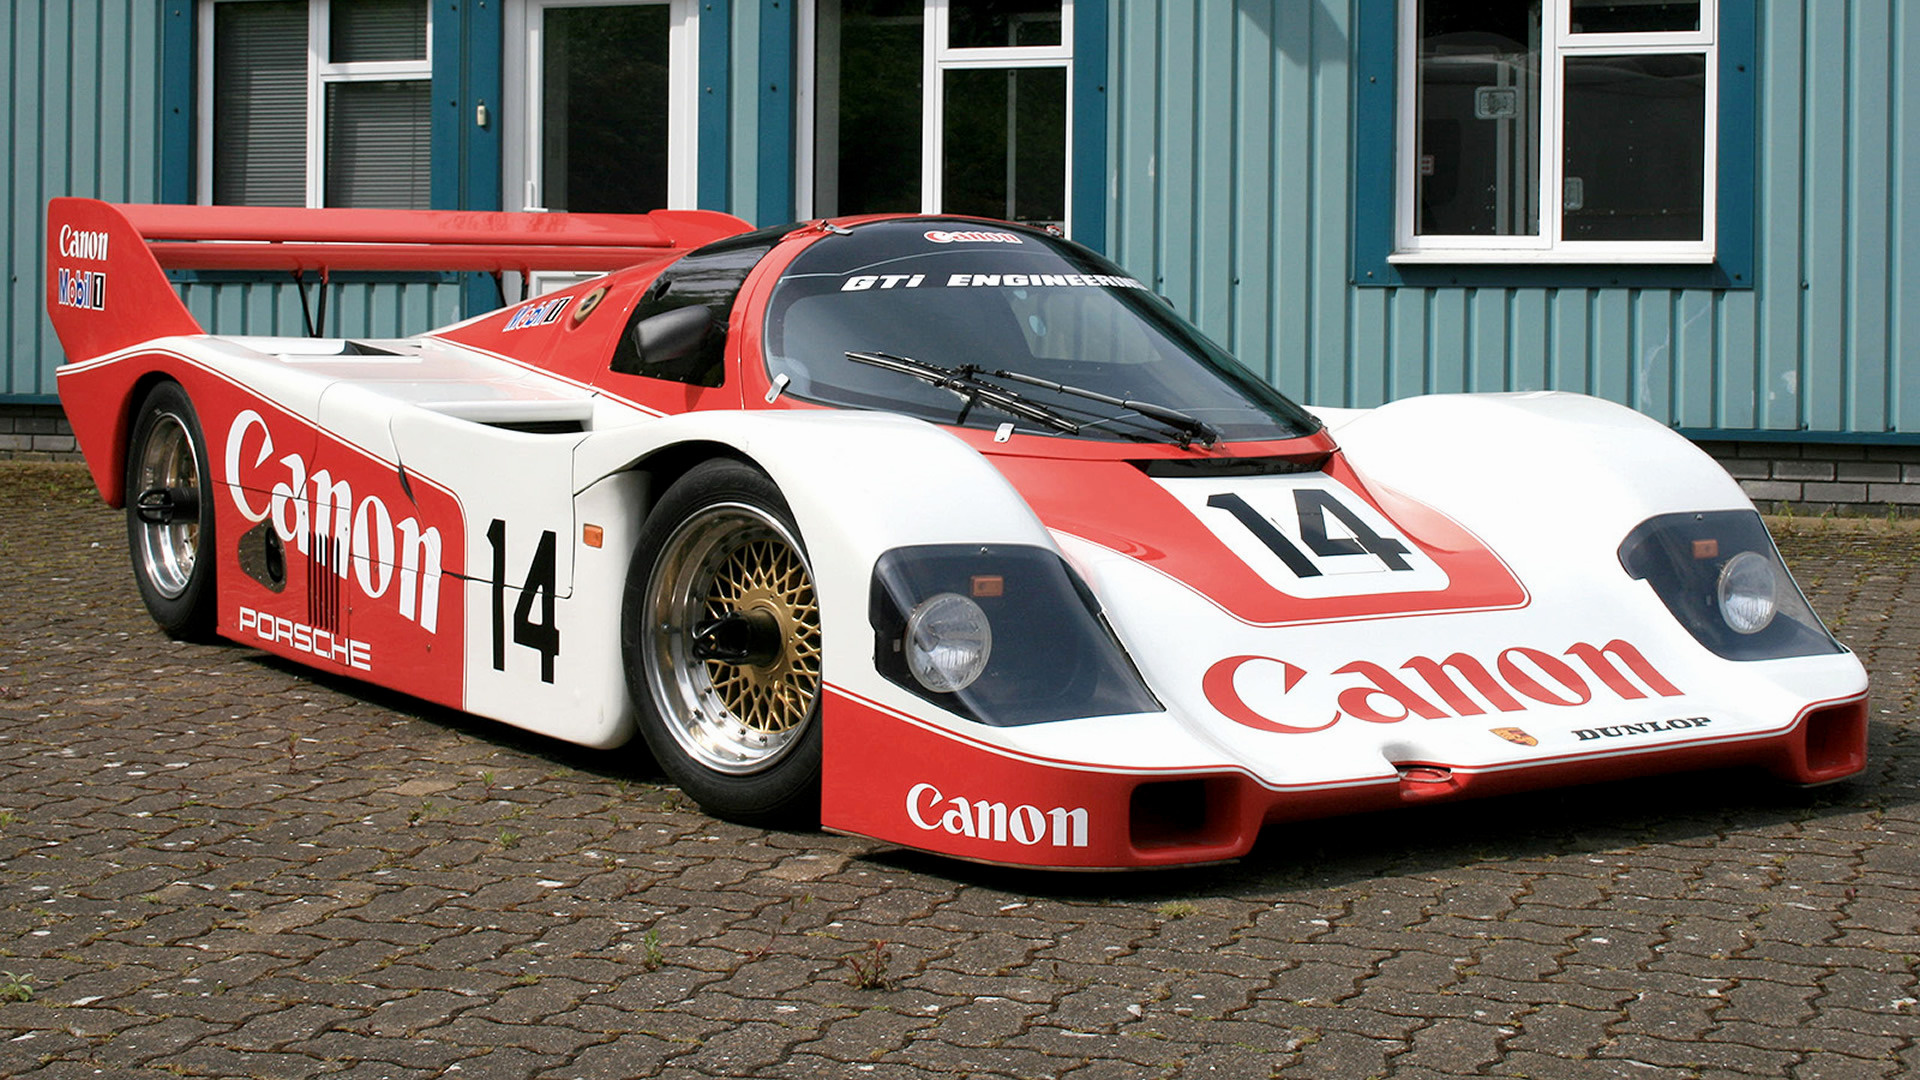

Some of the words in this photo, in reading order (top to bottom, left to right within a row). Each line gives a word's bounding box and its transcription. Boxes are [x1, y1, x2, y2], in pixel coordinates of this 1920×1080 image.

[59, 224, 109, 261] Canon
[924, 230, 1023, 244] Canon
[58, 268, 92, 309] Mobil
[93, 273, 105, 309] 1
[502, 298, 560, 332] Mobil
[225, 409, 443, 634] Canon
[1206, 488, 1415, 579] 14
[486, 518, 560, 684] 14
[239, 606, 372, 672] PORSCHE
[1203, 638, 1686, 734] Canon
[1571, 716, 1712, 741] DUNLOP
[905, 782, 1089, 847] Canon
